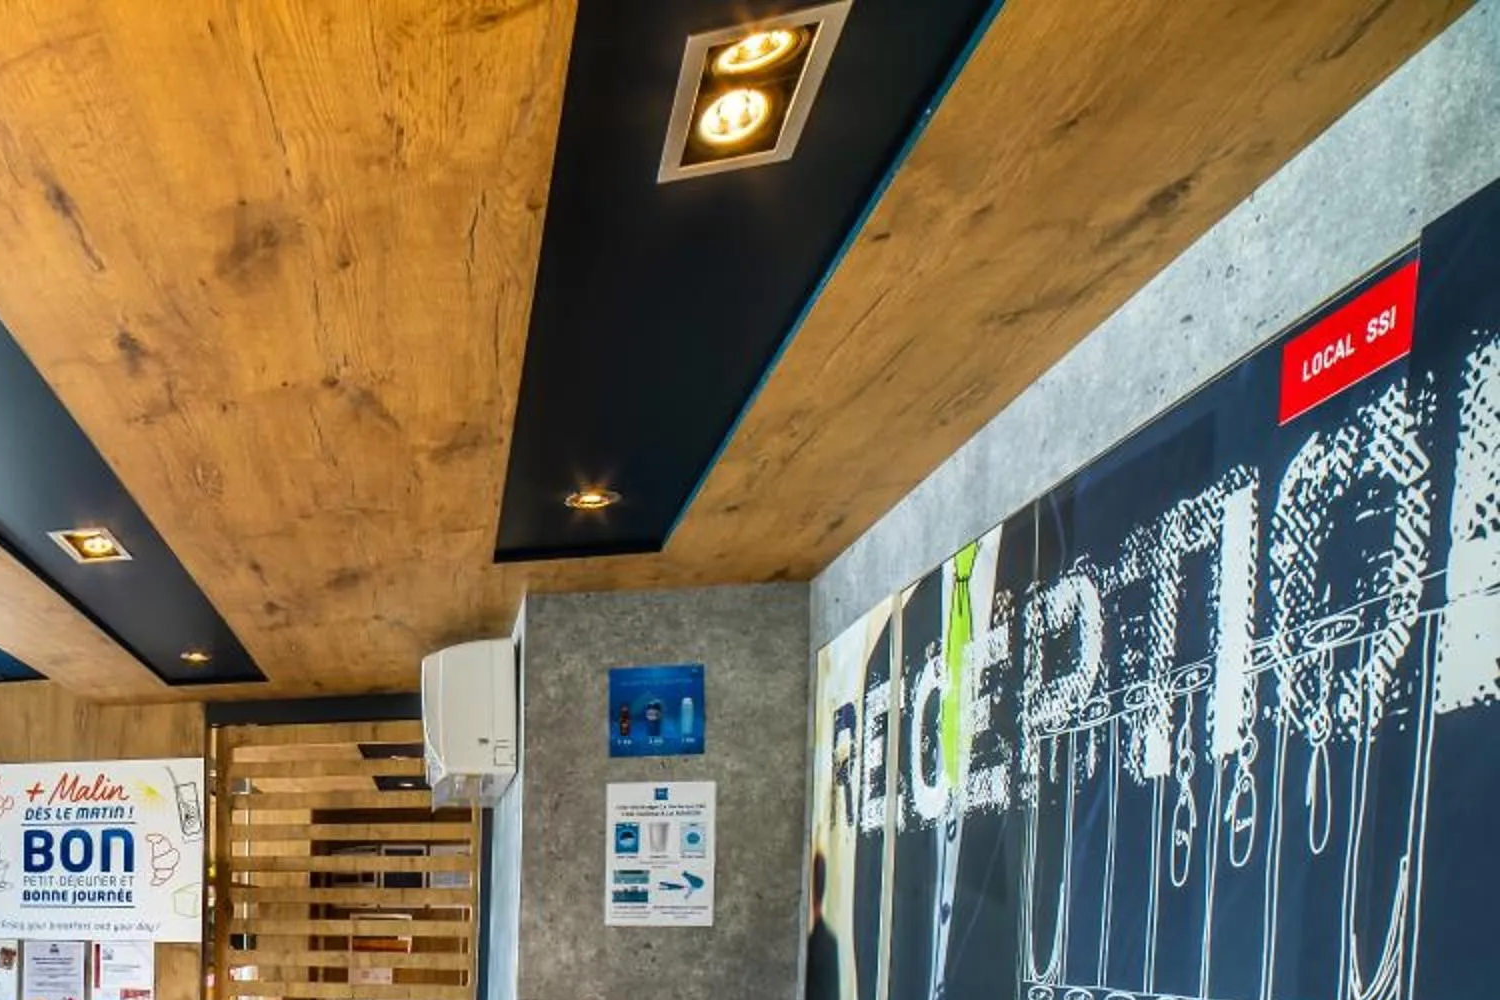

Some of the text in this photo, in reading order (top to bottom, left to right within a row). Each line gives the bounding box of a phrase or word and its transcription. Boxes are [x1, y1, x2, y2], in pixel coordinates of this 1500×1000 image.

[1301, 305, 1398, 383] LOCAL SSI
[48, 771, 130, 805] Malin
[55, 807, 73, 820] LE
[76, 806, 126, 820] MATIN
[23, 828, 135, 873] BON
[120, 875, 135, 887] ET
[23, 888, 133, 904] BONNE JOURNÉE
